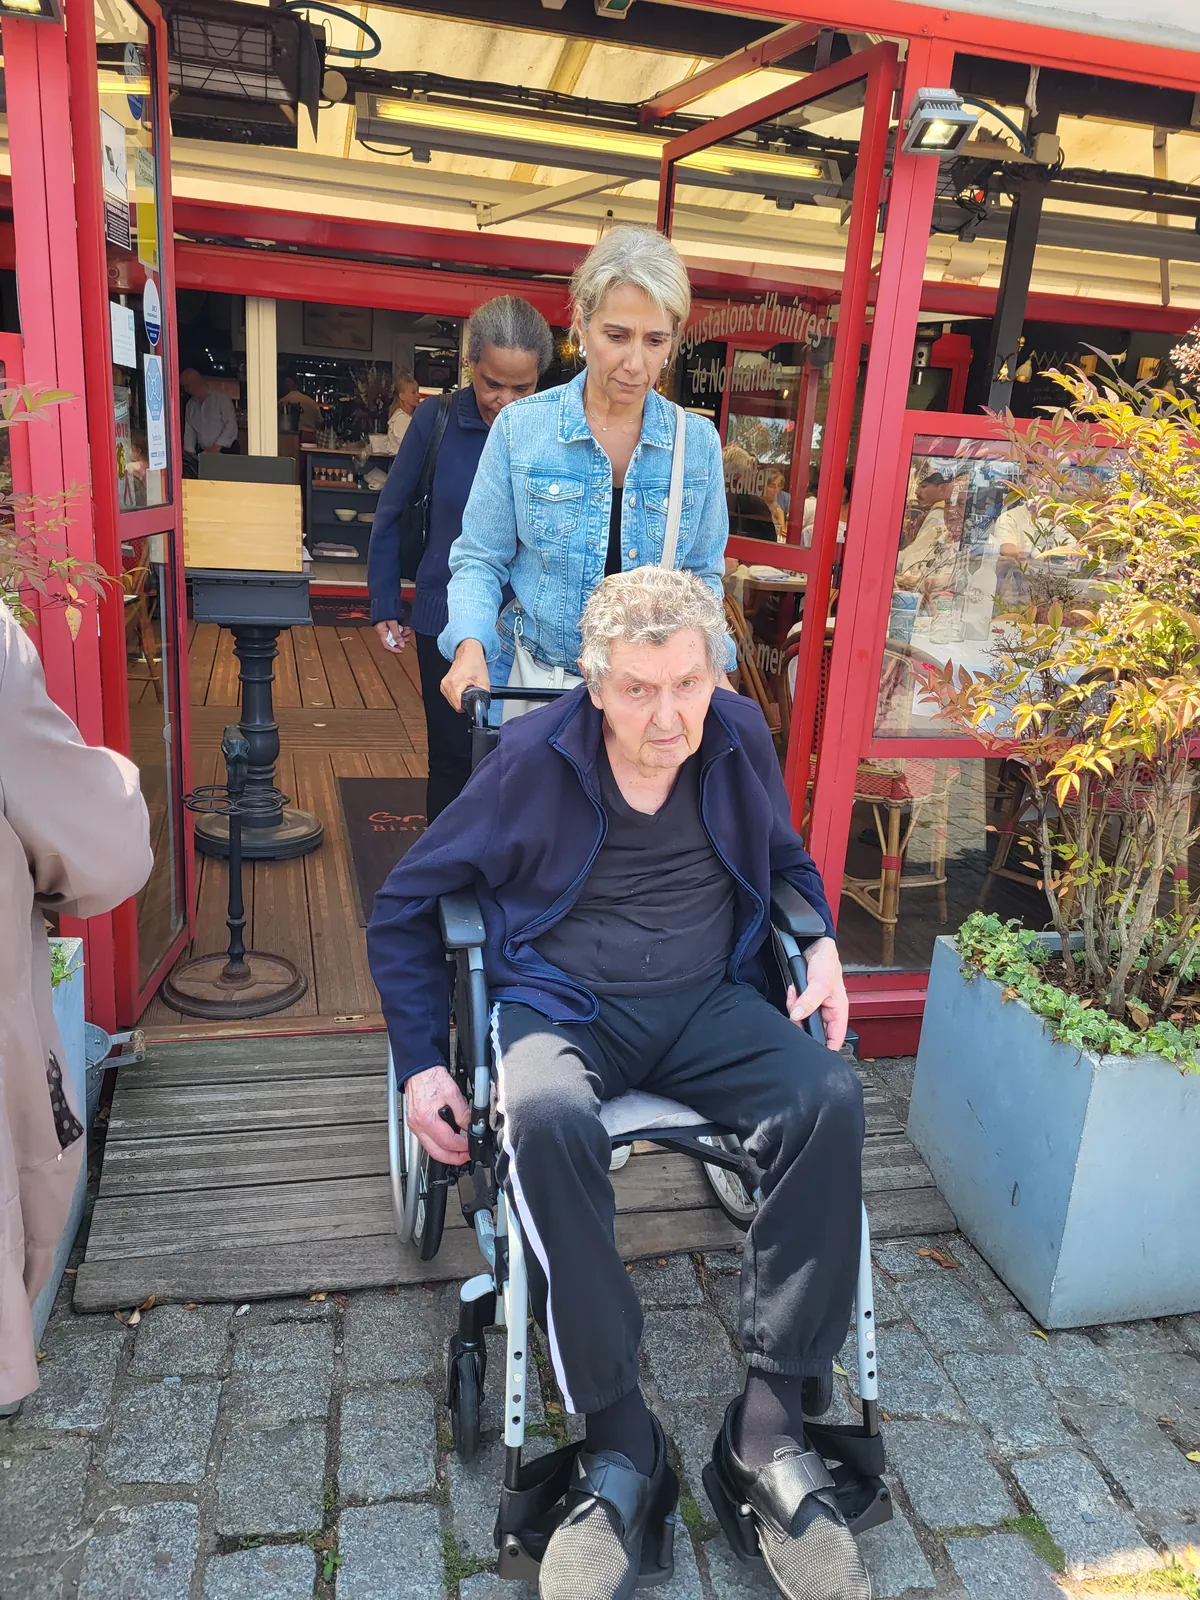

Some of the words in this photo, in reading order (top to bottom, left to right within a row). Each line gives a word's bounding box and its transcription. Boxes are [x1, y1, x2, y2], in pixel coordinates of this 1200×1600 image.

[755, 292, 826, 348] d'huîtres
[692, 358, 707, 394] de
[709, 351, 783, 393] Normandie
[757, 643, 786, 676] mer
